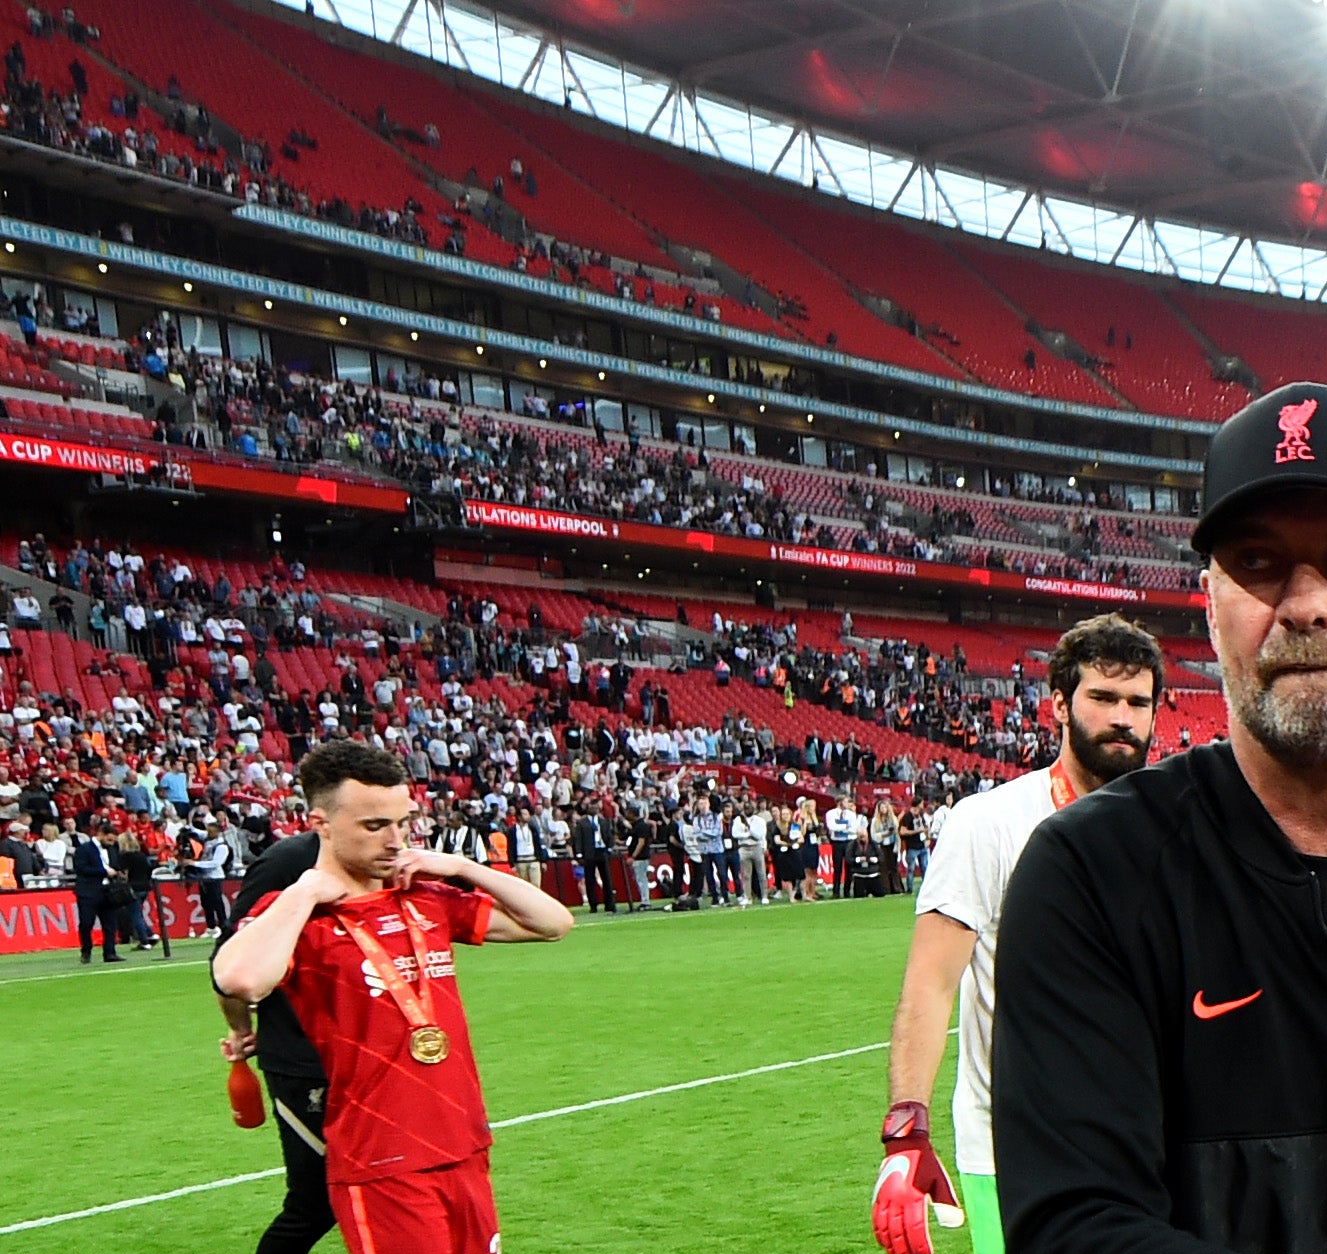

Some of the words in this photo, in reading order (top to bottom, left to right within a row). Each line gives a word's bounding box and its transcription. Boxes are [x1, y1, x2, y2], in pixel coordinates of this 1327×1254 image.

[302, 219, 379, 251] CONNECTED
[108, 246, 179, 273] WEMBLEY
[182, 262, 263, 290] CONNECTED
[424, 250, 479, 275] WEMBLEY
[480, 264, 546, 293] CONNECTED
[313, 291, 373, 315] WEMBLEY
[375, 304, 444, 333] CONNECTED
[12, 441, 51, 461] CUP
[540, 515, 607, 536] LIVERPOOL
[816, 552, 829, 565] FA
[830, 554, 849, 568] CUP
[852, 557, 893, 573] WINNERS
[895, 562, 916, 575] 2022
